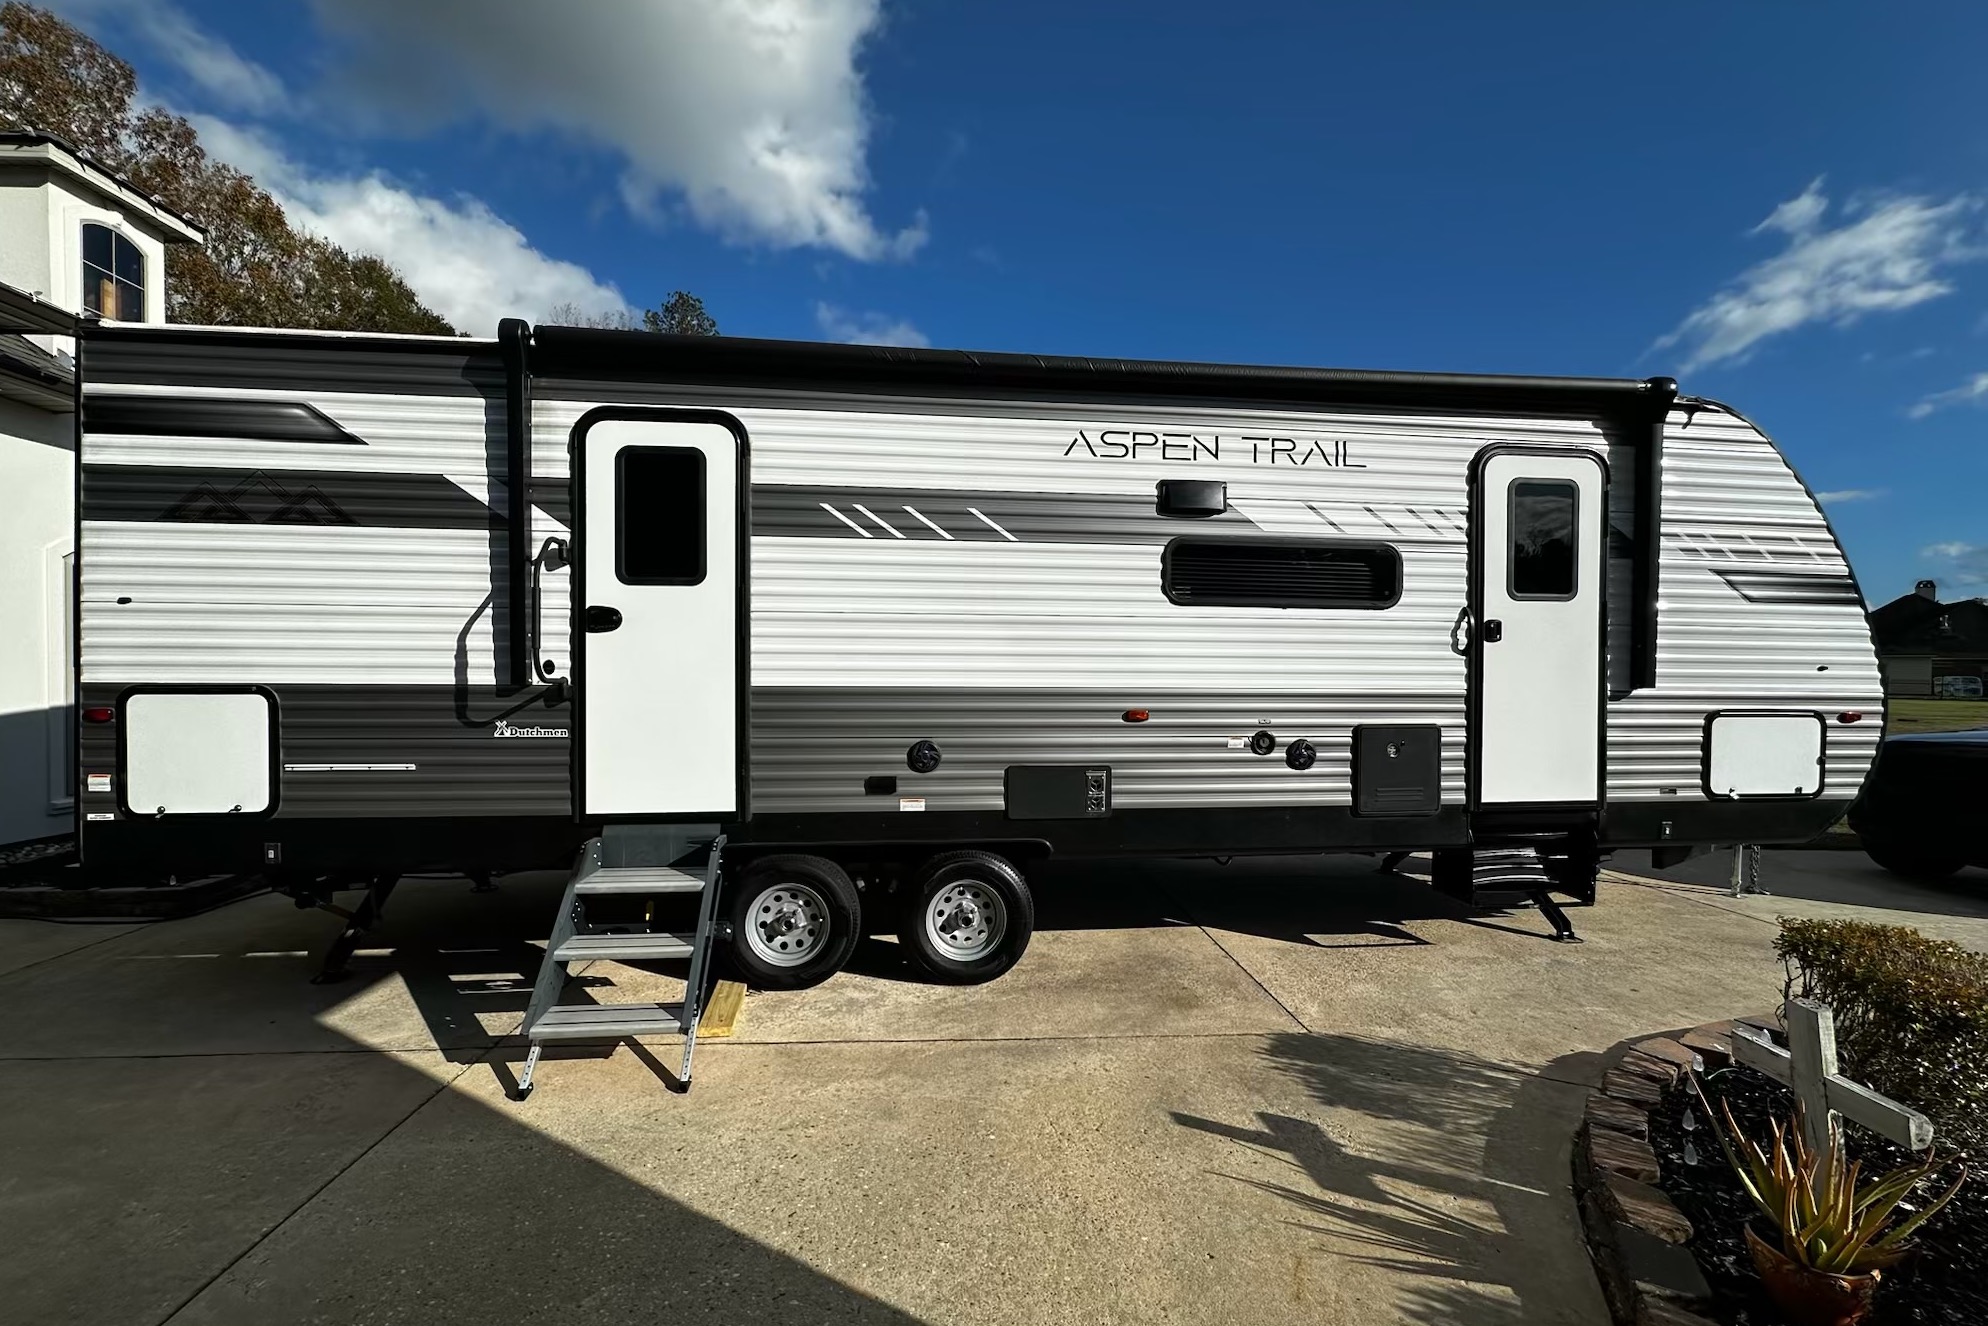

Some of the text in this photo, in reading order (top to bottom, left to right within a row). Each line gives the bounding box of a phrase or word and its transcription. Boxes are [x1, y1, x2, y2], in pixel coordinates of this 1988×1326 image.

[1063, 429, 1367, 468] ASPEN TRAIL
[509, 726, 568, 737] Dutchmen
